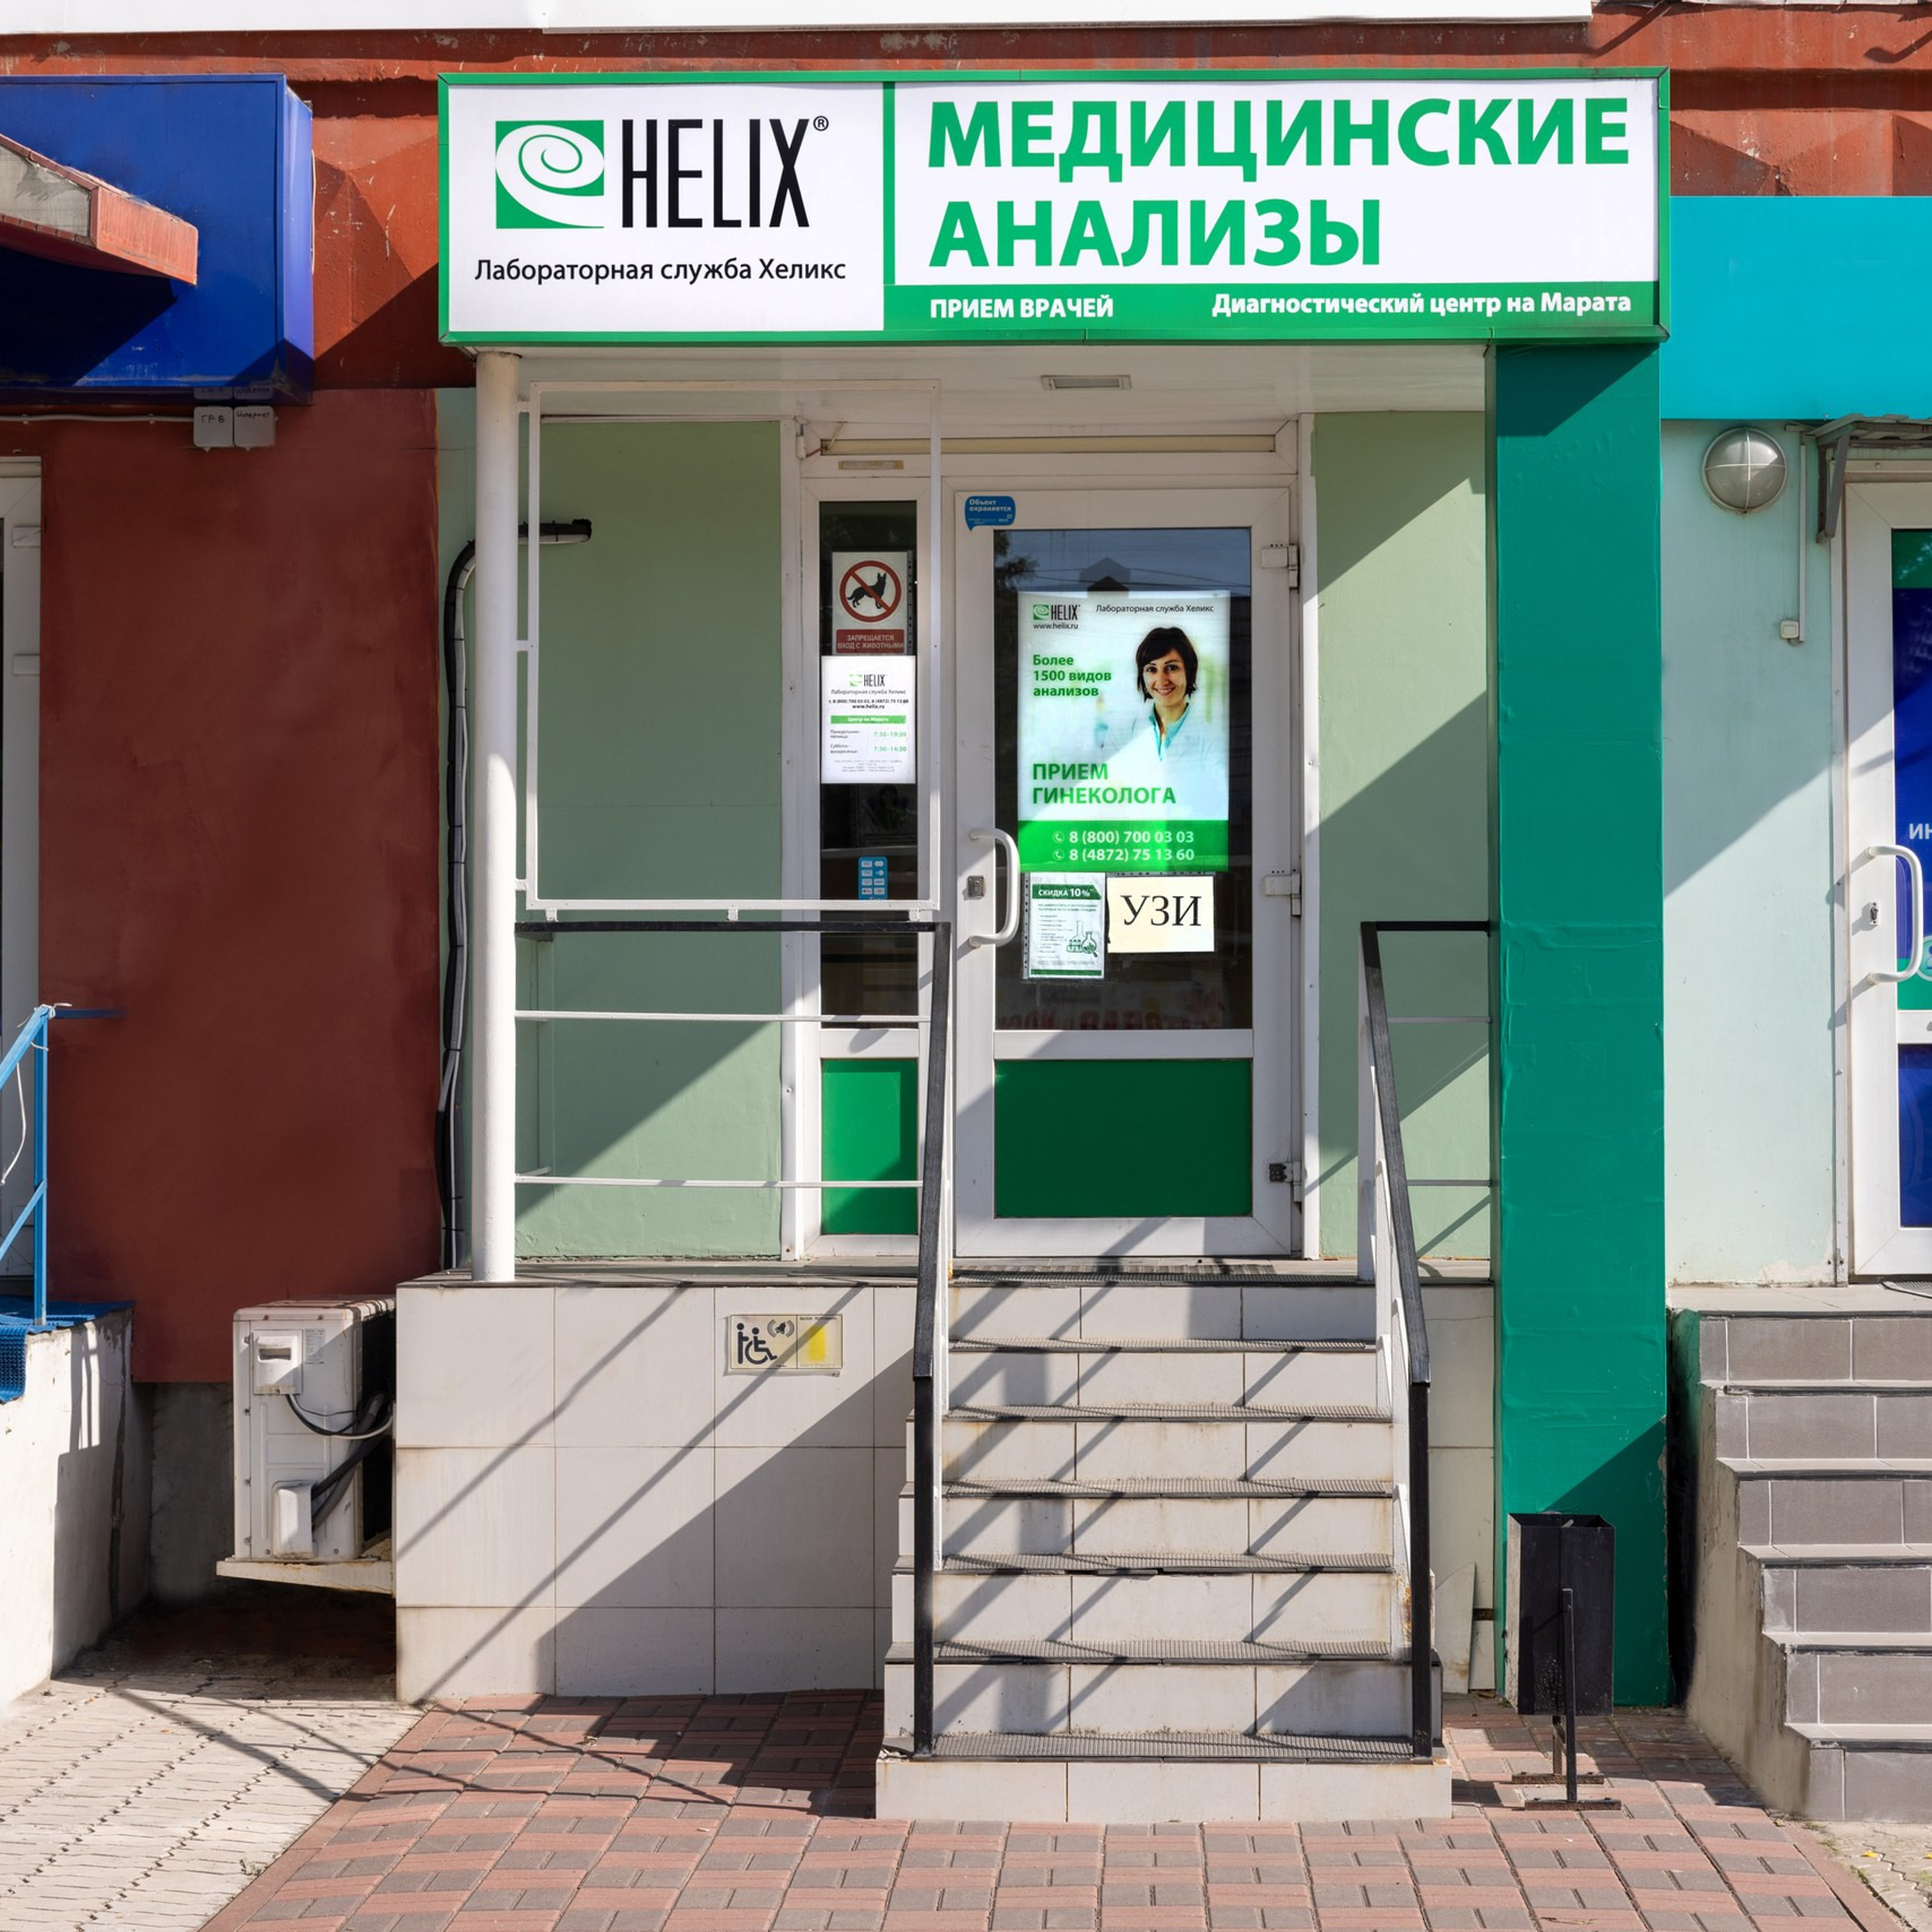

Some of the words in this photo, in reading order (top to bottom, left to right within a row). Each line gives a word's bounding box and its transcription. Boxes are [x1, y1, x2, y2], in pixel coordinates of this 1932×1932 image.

[928, 97, 1629, 183] МЕДИЦИНСКИЕ
[929, 198, 1380, 267] АНАЛИЗЫ
[475, 260, 653, 285] Лабораторная
[660, 258, 752, 285] служба
[758, 259, 846, 279] Хеликс
[931, 300, 1015, 318] ПРИЕМ
[1020, 294, 1113, 318] ВРАЧЕЙ
[1212, 292, 1423, 318] Диагностический
[1430, 297, 1501, 318] центр
[1506, 297, 1536, 312] на
[1541, 292, 1631, 317] Марата
[1051, 605, 1078, 620] HELIX
[1096, 605, 1154, 614] Лабораторная
[1155, 605, 1184, 614] служба
[1033, 654, 1074, 666] Более
[864, 675, 884, 687] HELIX
[1033, 671, 1066, 681] 1500
[1069, 672, 1112, 682] видов
[1033, 688, 1099, 697] анализов
[1032, 764, 1108, 780] ПРИЕМ
[1032, 787, 1176, 804] ГИНЕКОЛОГА
[1069, 832, 1078, 843] 8
[1082, 832, 1120, 844] (800)
[1124, 832, 1151, 843] 700
[1154, 832, 1173, 843] 03
[1176, 832, 1194, 843] 03
[1069, 850, 1078, 860] 8
[1082, 849, 1129, 862] (4872)
[1133, 850, 1151, 860] 75
[1155, 850, 1173, 860] 13
[1176, 850, 1195, 860] 60
[1120, 895, 1201, 926] УЗИ
